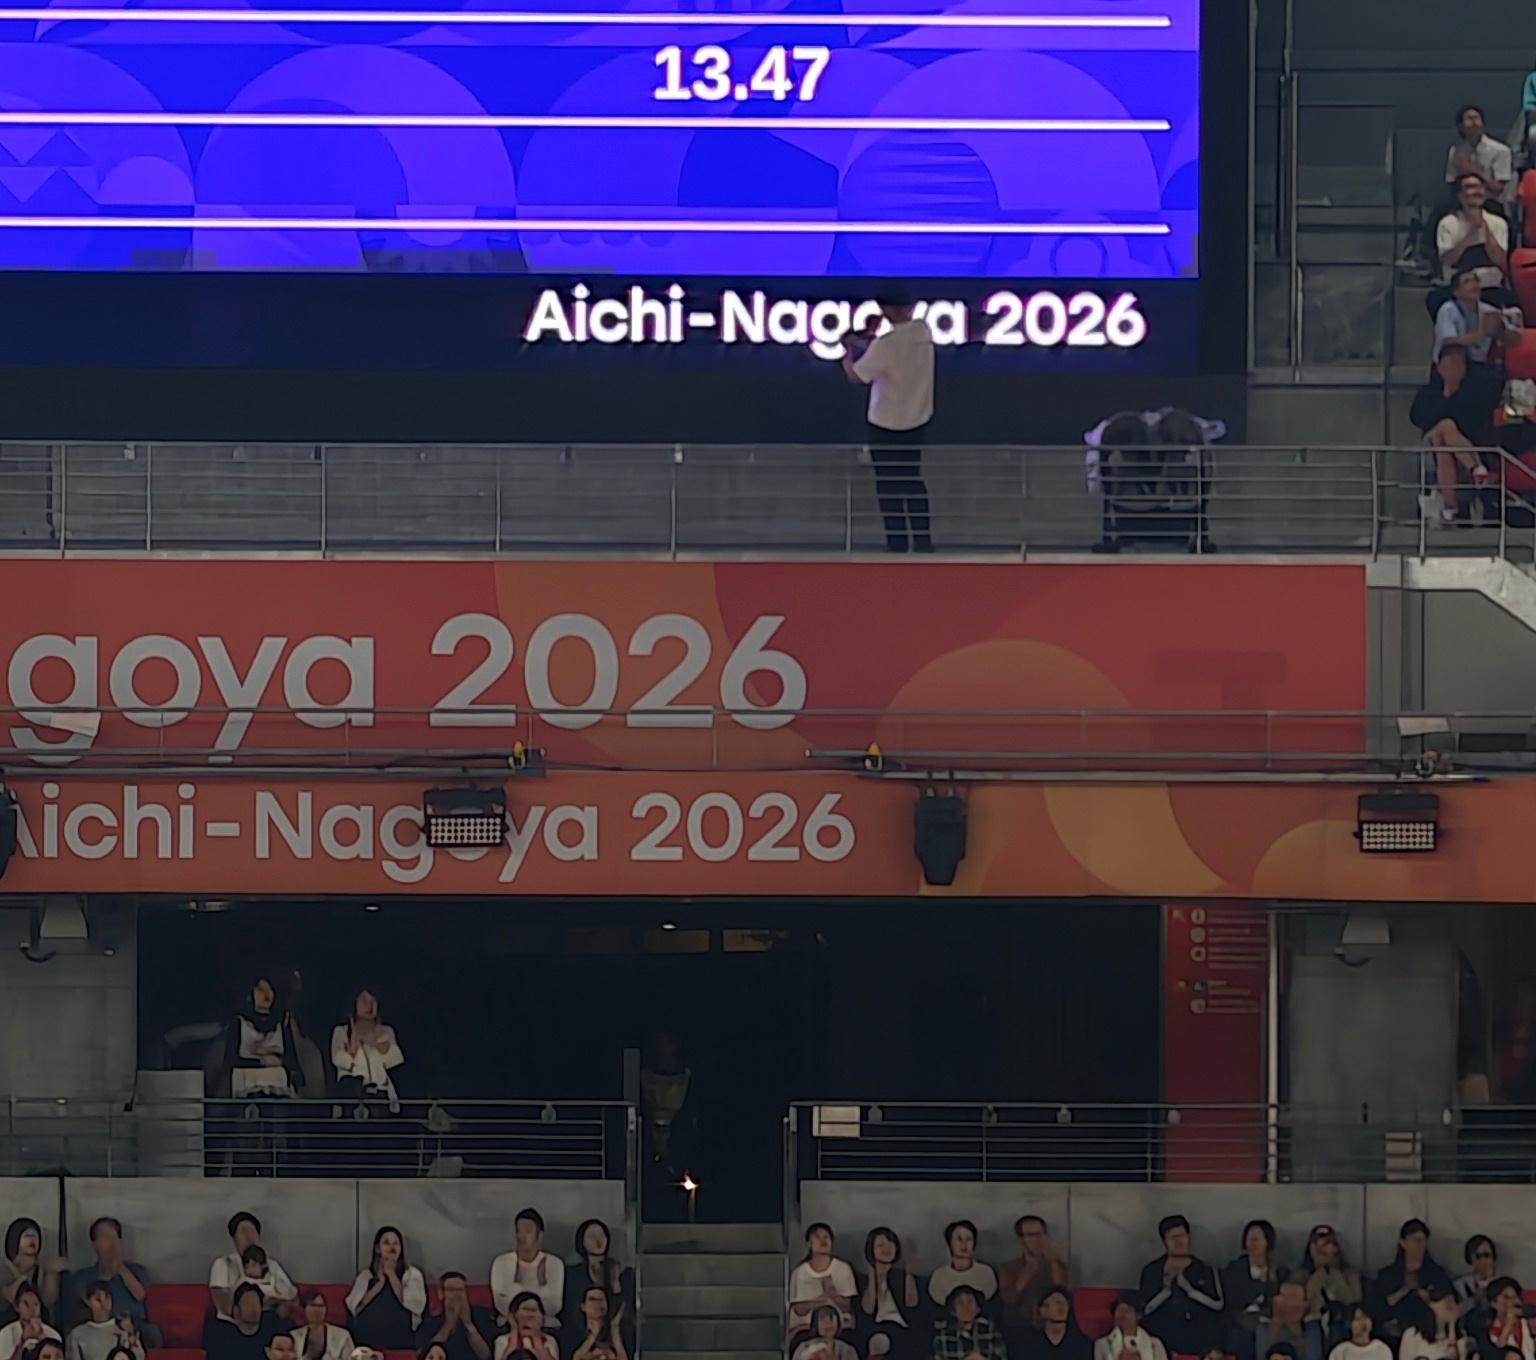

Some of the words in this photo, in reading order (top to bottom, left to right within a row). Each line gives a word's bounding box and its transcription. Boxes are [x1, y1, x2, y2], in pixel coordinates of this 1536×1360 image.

[655, 47, 829, 100] 13.47
[986, 293, 1144, 345] 2026
[429, 613, 807, 730] 2026
[11, 782, 597, 883] ichi-Nagya
[630, 792, 856, 863] 2026
